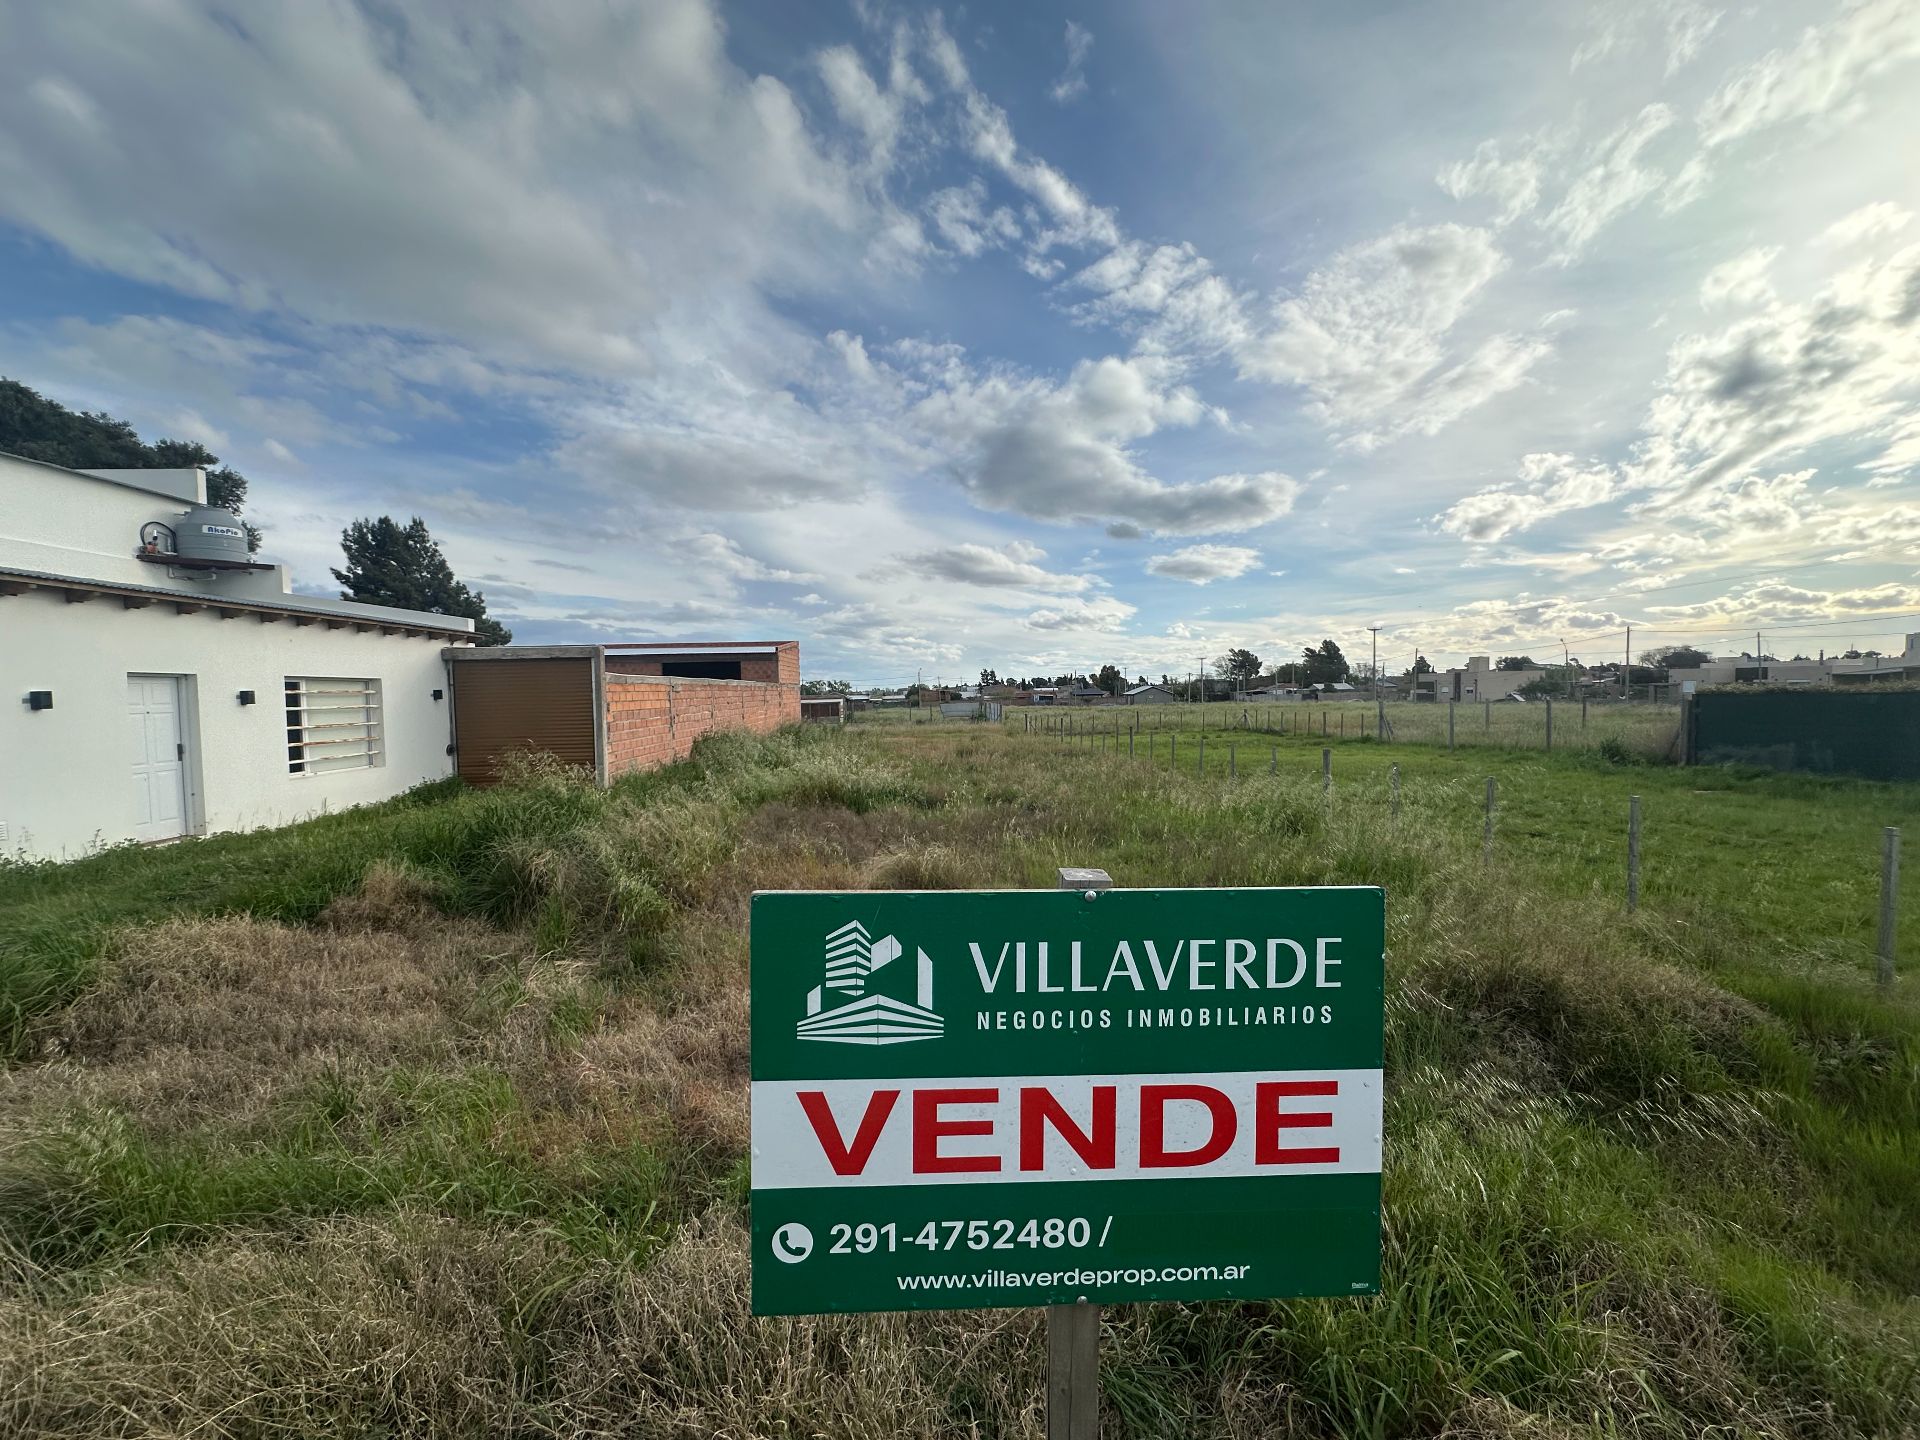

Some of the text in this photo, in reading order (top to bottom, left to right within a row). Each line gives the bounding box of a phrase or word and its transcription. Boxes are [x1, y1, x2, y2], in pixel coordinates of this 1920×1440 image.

[968, 937, 1343, 994] VILLAVERDE
[976, 1005, 1333, 1030] NEGOCIOS INMOBILIARIOS
[796, 1080, 1341, 1176] VENDE
[829, 1217, 1091, 1254] 291-4752480
[896, 1265, 1251, 1290] www.villaverdeprop.com.ar
